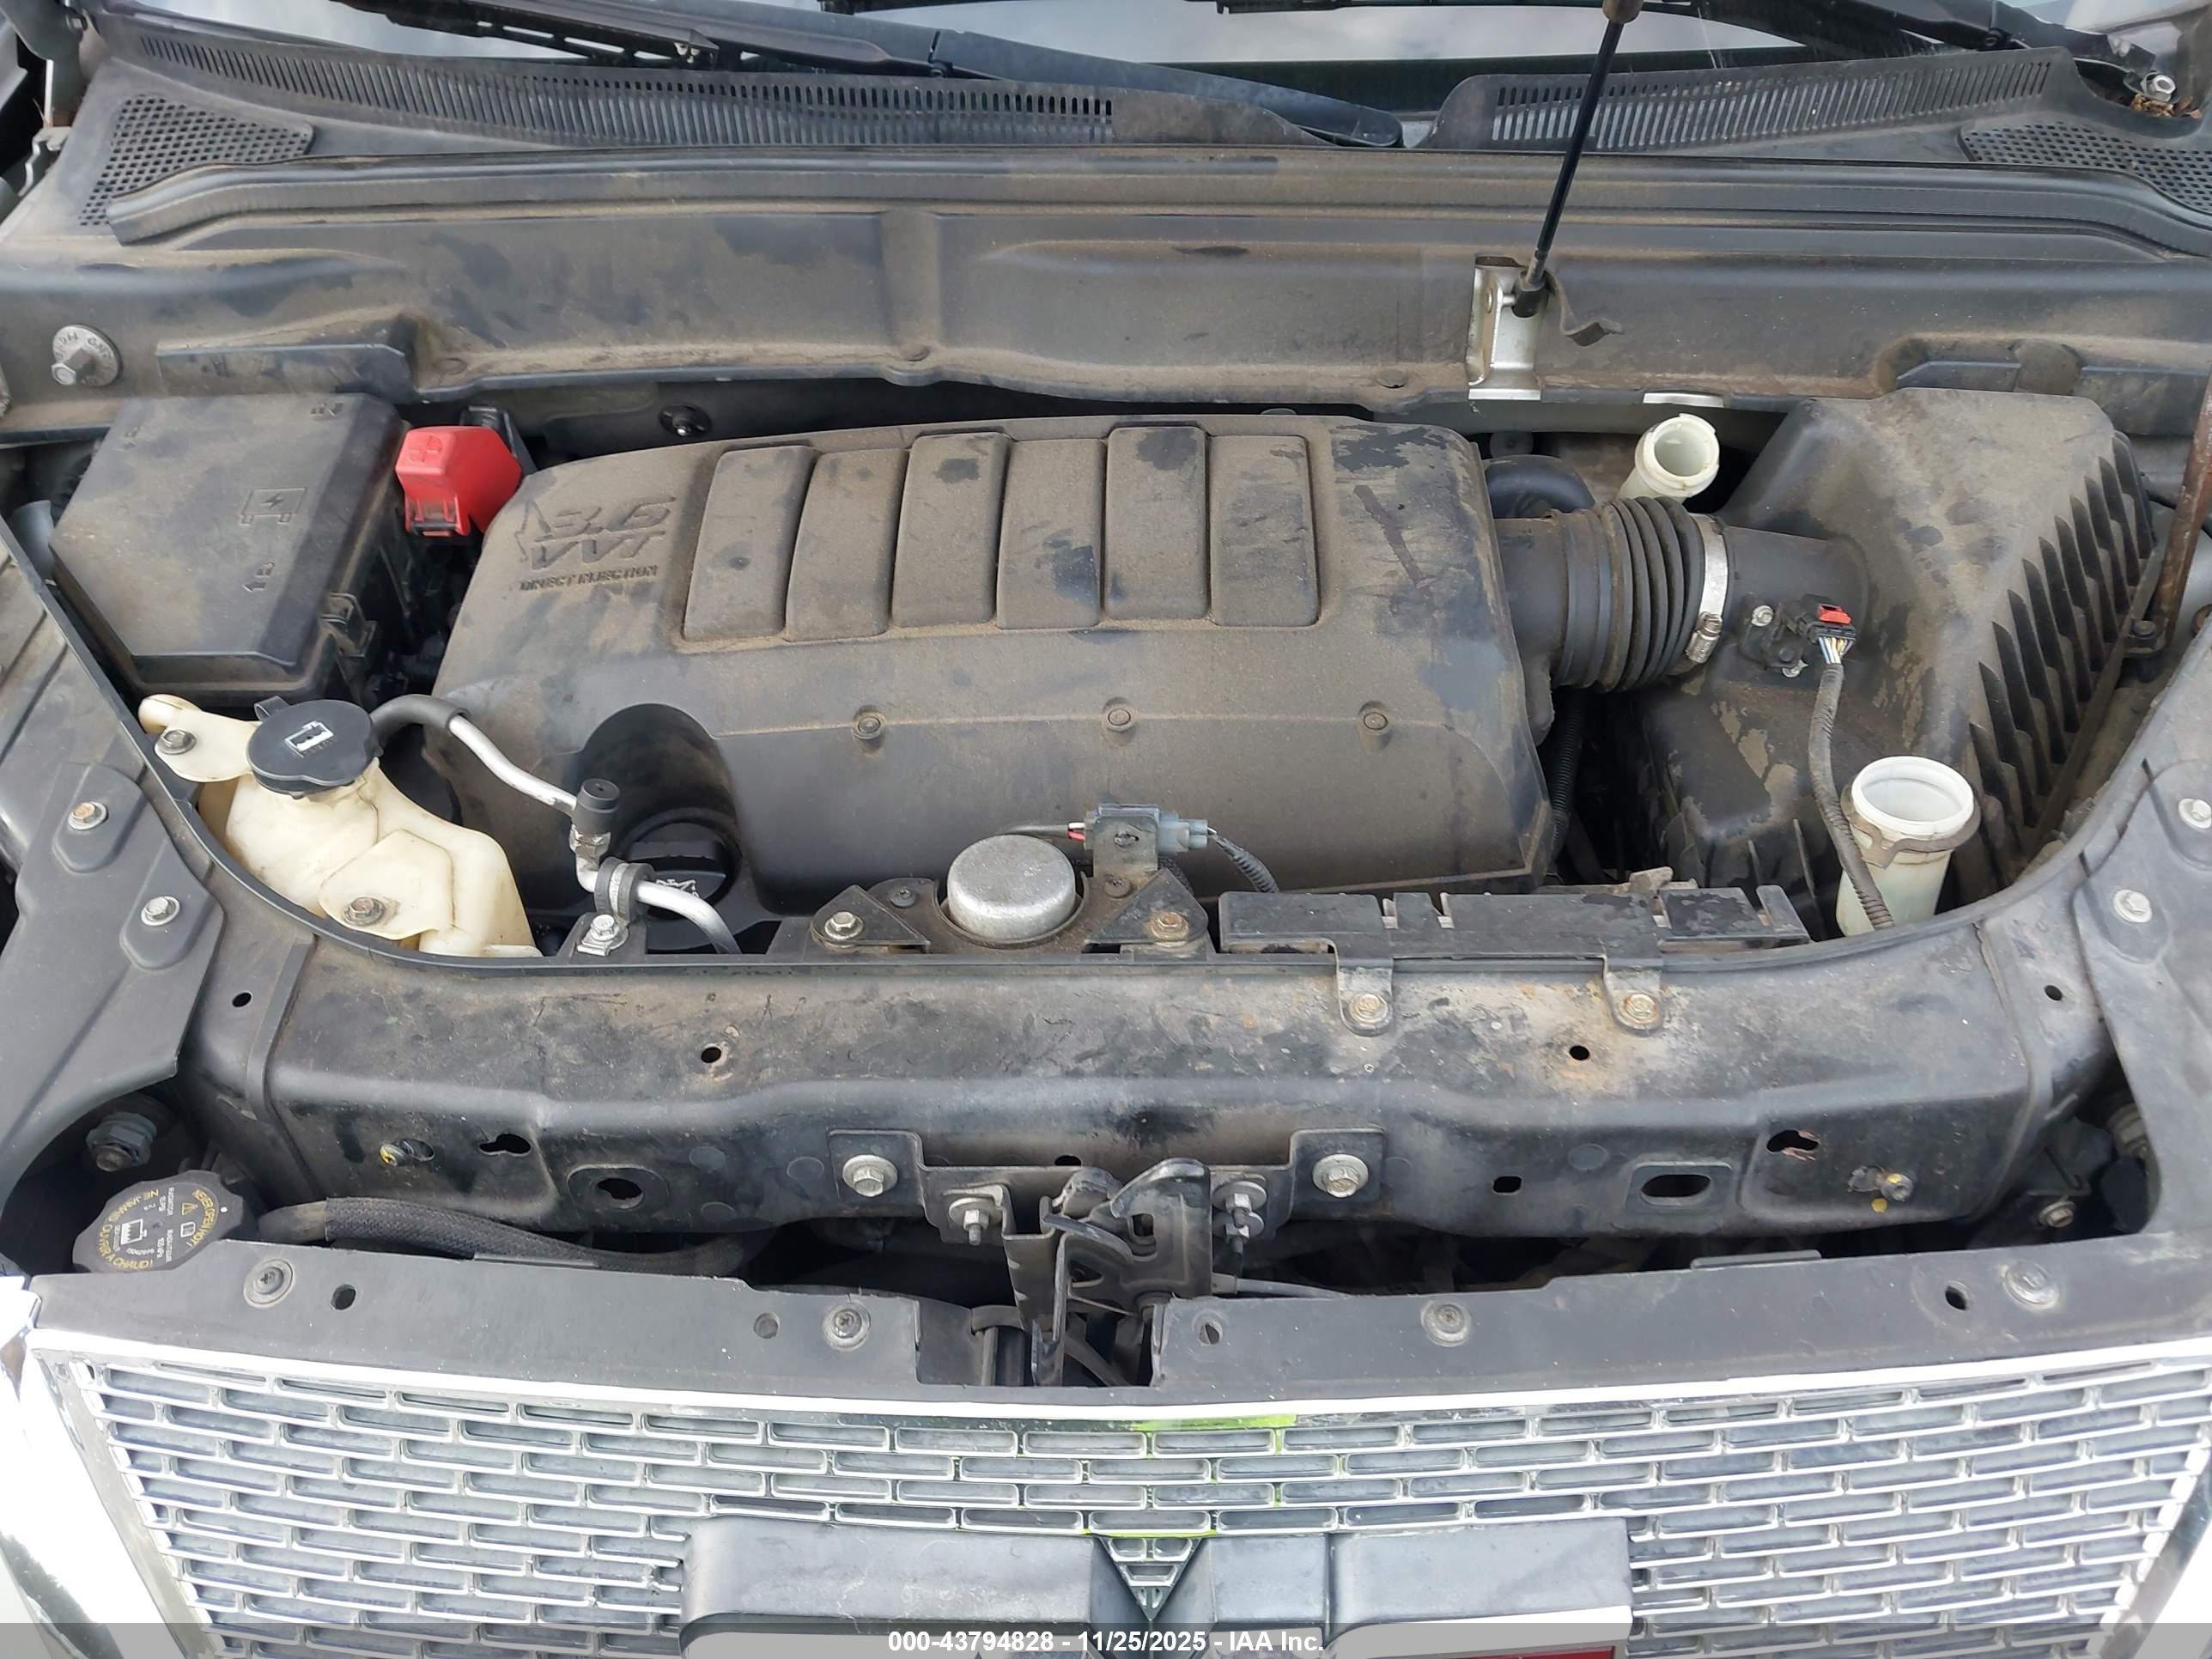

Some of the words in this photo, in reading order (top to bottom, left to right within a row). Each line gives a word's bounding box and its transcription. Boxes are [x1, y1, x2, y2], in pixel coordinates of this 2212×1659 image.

[531, 530, 666, 571] VVT
[519, 575, 576, 592] DIRECT
[578, 564, 659, 585] INJECTION
[192, 1188, 214, 1208] NEVER
[203, 1208, 216, 1228] OPEN
